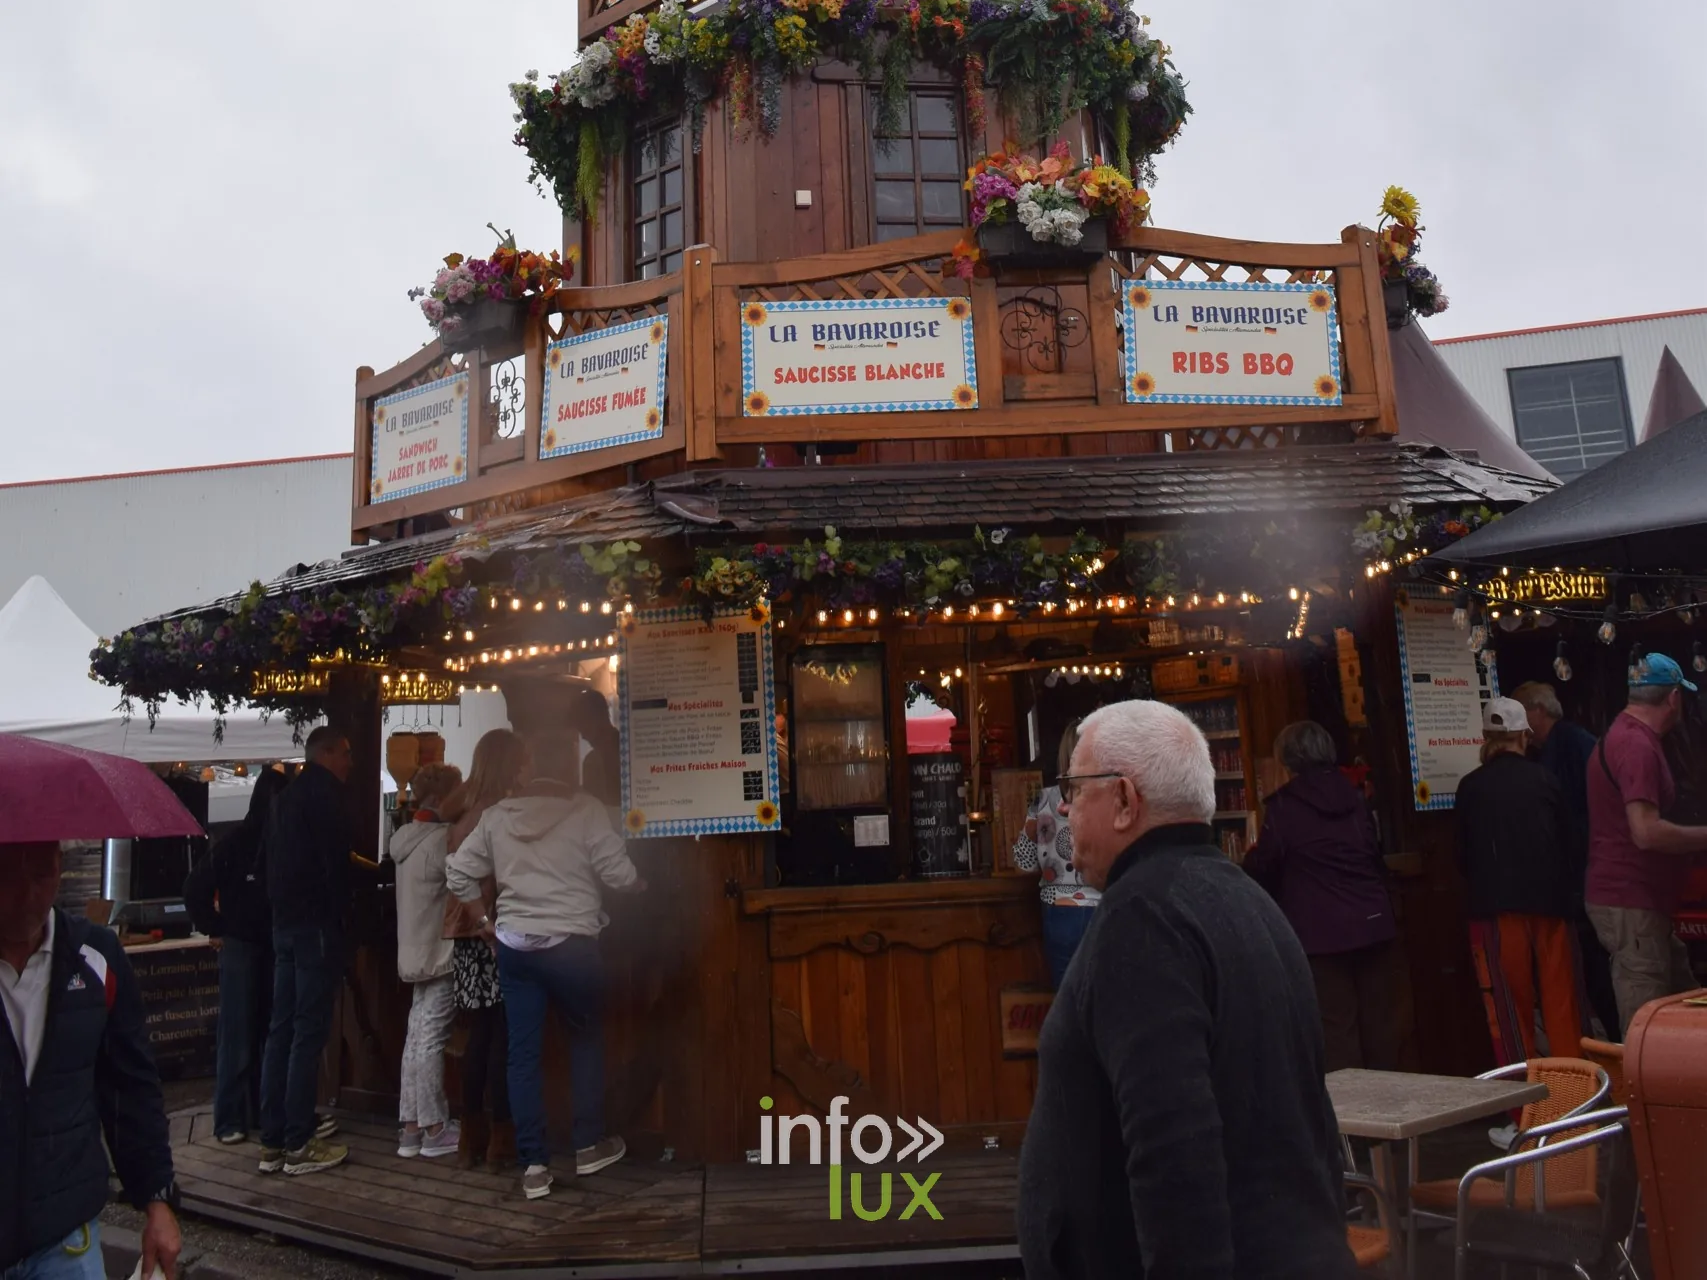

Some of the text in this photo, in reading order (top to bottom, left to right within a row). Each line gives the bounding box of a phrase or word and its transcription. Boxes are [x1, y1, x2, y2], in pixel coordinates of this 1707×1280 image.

[1153, 305, 1308, 325] LA BAVAROISE
[769, 320, 941, 343] LA BAVAROISE
[560, 360, 574, 379] LA
[581, 342, 648, 375] BAVAROISE
[1172, 352, 1293, 376] RIBS BBQ
[773, 362, 945, 385] SAUCISSE BLANCHE
[557, 385, 646, 422] SAUCISSE FUMÉE
[386, 416, 397, 433] LA
[402, 398, 454, 428] BAVAROISE
[399, 438, 438, 461] SANDWICH
[388, 454, 448, 483] JARRET DE PORC
[668, 700, 724, 711] Nos Spécialités
[651, 765, 663, 773] Nos
[666, 764, 686, 772] Frites
[720, 759, 747, 769] Maison
[930, 762, 962, 775] CHAUD
